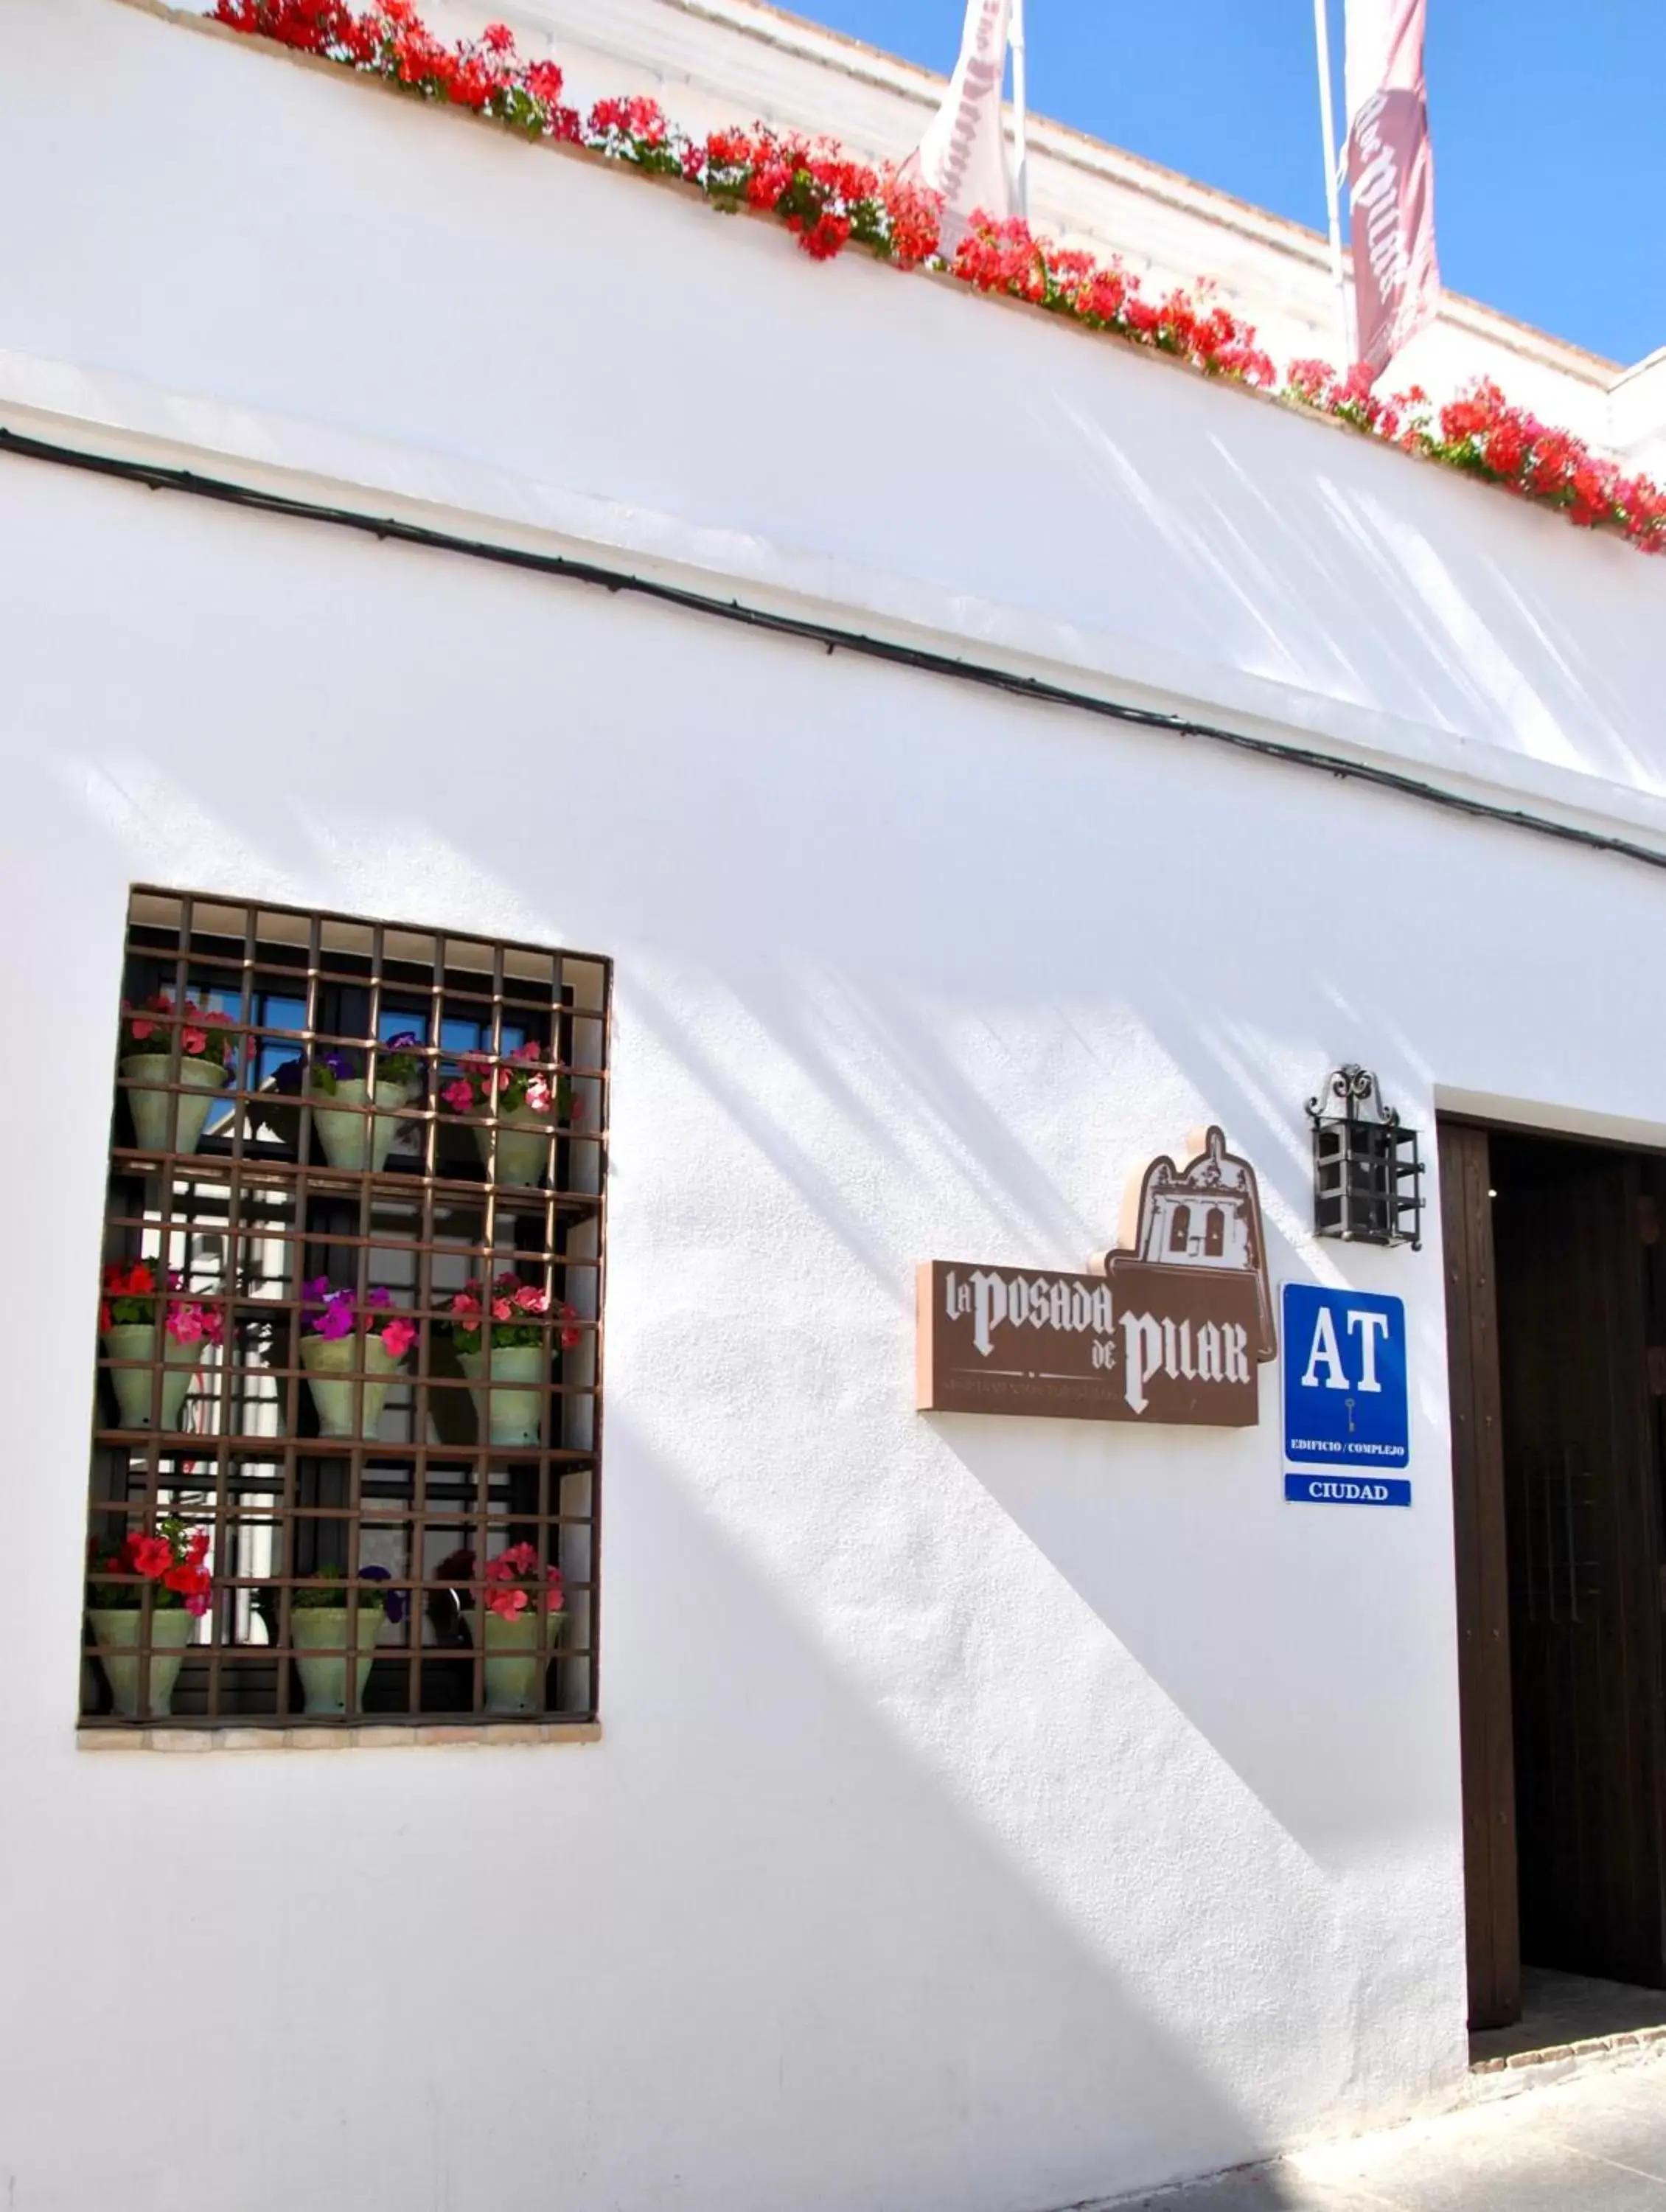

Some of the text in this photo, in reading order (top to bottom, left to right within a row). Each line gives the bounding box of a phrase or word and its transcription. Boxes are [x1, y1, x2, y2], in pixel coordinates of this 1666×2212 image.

[969, 1269, 1115, 1357] POSADA
[1301, 1307, 1389, 1393] AT
[1092, 1309, 1251, 1415] DE PILAR
[1308, 1481, 1389, 1500] CIUDAD
